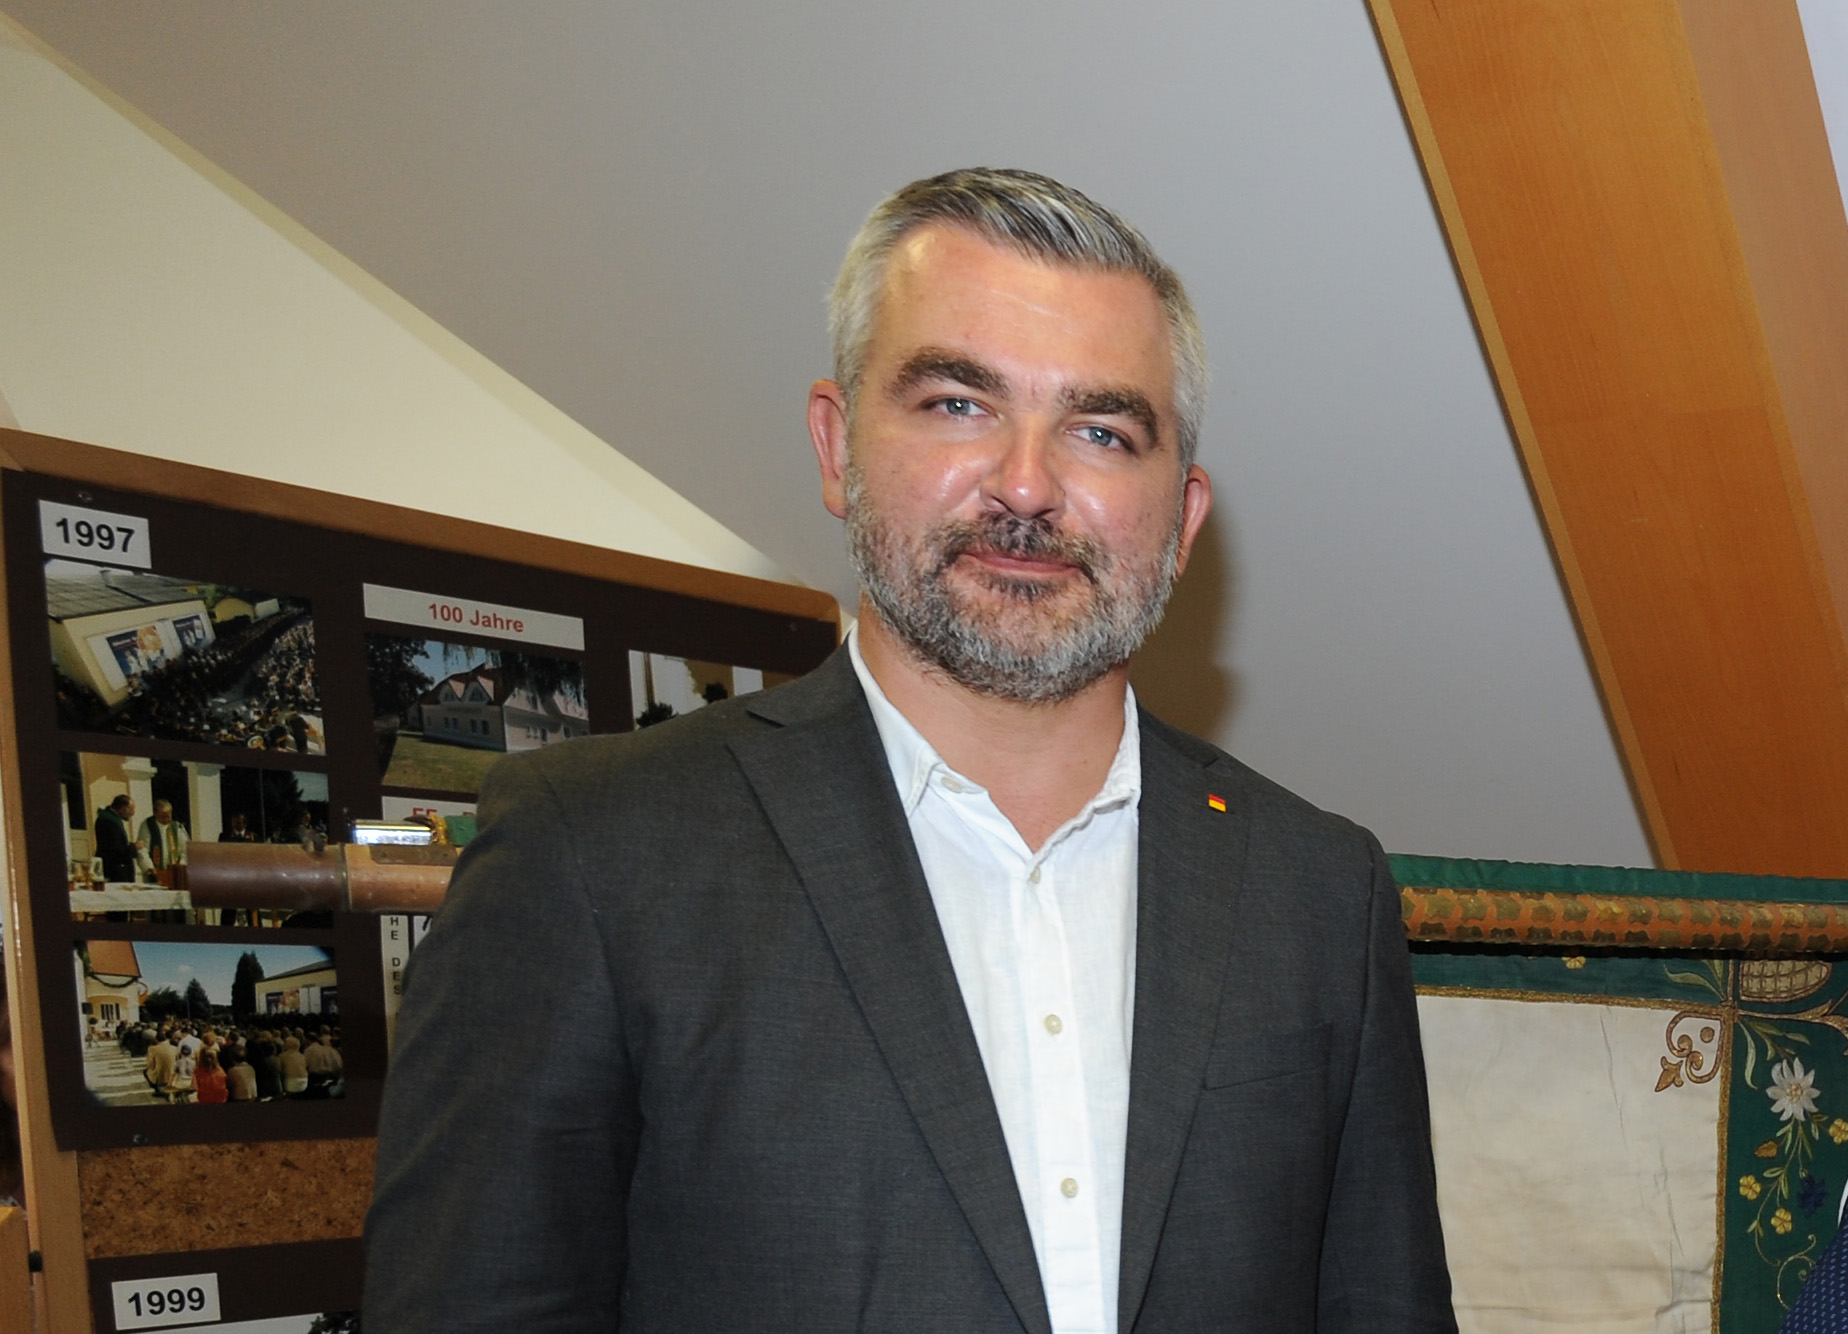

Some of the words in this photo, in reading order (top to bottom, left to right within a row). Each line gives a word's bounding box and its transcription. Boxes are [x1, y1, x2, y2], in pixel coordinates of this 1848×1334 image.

[55, 517, 136, 553] 1997
[429, 603, 463, 623] 100
[470, 609, 524, 633] Jahre
[127, 1286, 206, 1317] 1999
